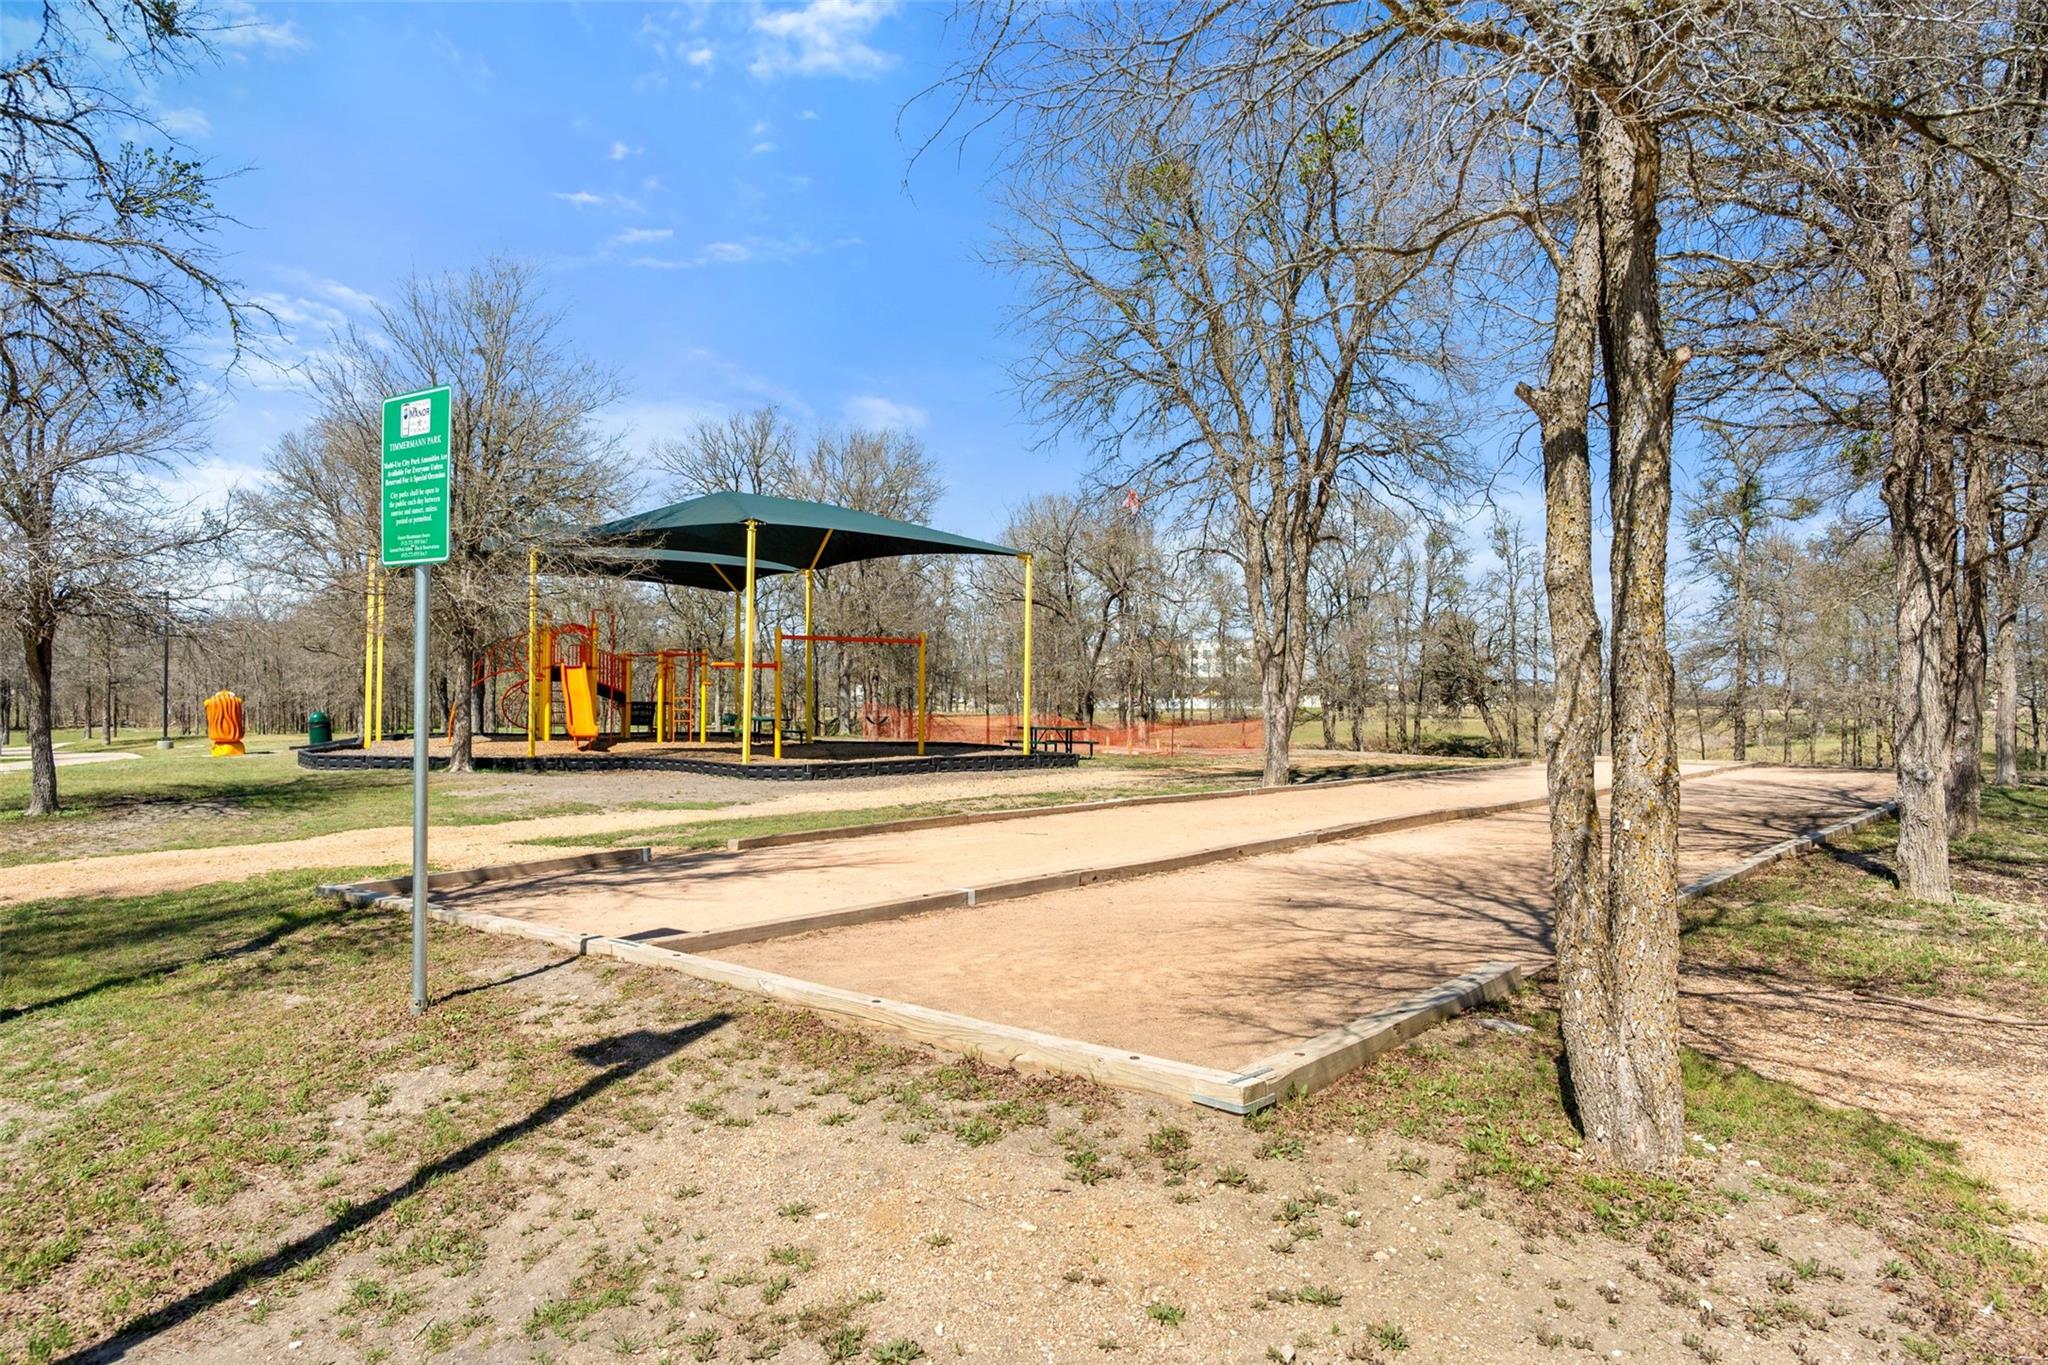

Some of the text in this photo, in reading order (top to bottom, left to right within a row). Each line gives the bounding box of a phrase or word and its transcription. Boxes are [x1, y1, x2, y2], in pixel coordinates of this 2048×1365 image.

[390, 435, 442, 452] TIMMERMANN PARK
[414, 474, 427, 483] Special
[399, 491, 409, 500] parks
[395, 500, 407, 509] public
[396, 517, 408, 527] posted
